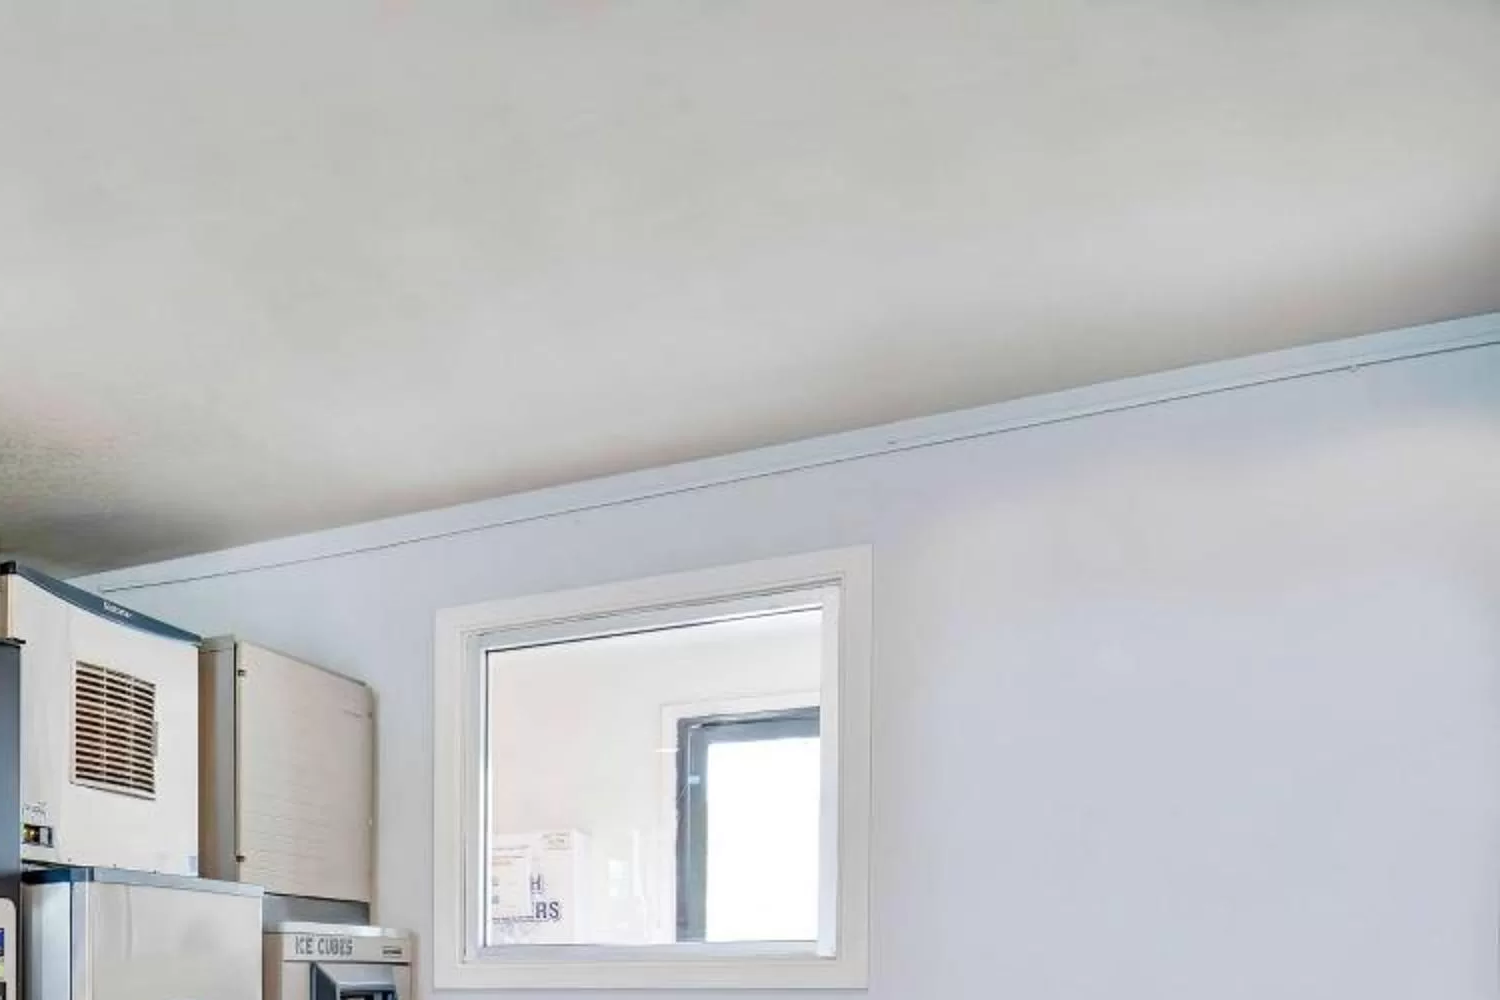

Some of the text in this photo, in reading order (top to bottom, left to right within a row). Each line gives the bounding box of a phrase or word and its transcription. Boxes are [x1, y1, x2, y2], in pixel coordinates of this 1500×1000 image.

[532, 900, 560, 920] RS
[295, 935, 354, 956] ICE CUBES
